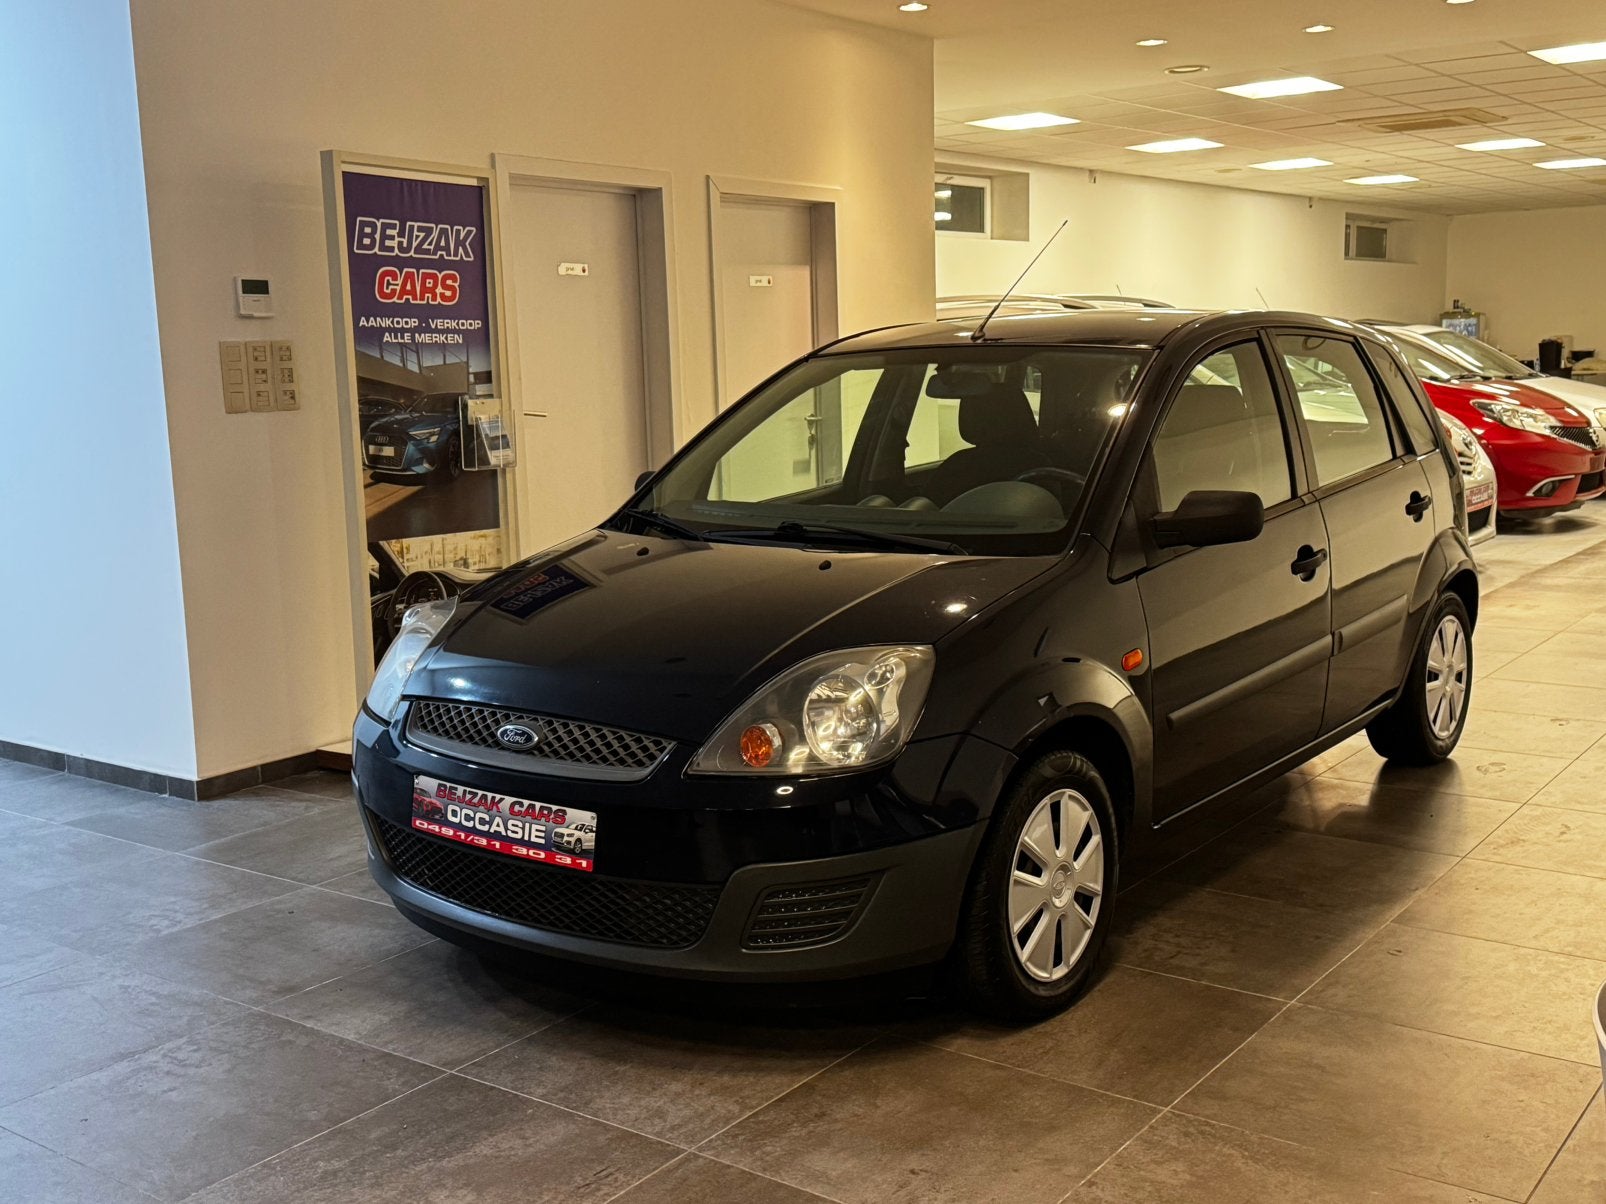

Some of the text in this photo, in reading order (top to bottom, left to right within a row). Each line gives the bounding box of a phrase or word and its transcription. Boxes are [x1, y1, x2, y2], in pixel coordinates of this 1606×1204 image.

[354, 217, 476, 261] BEJZAK
[375, 267, 460, 305] CARS
[359, 316, 419, 329] AANKOOP
[428, 318, 482, 330] VERKOOP
[383, 332, 463, 344] ALLE MERKEN
[503, 728, 528, 744] Ford
[435, 782, 568, 825] BEJZAK CARS
[446, 804, 546, 844] OCCASIE
[415, 820, 588, 868] 0491/31 30 31
